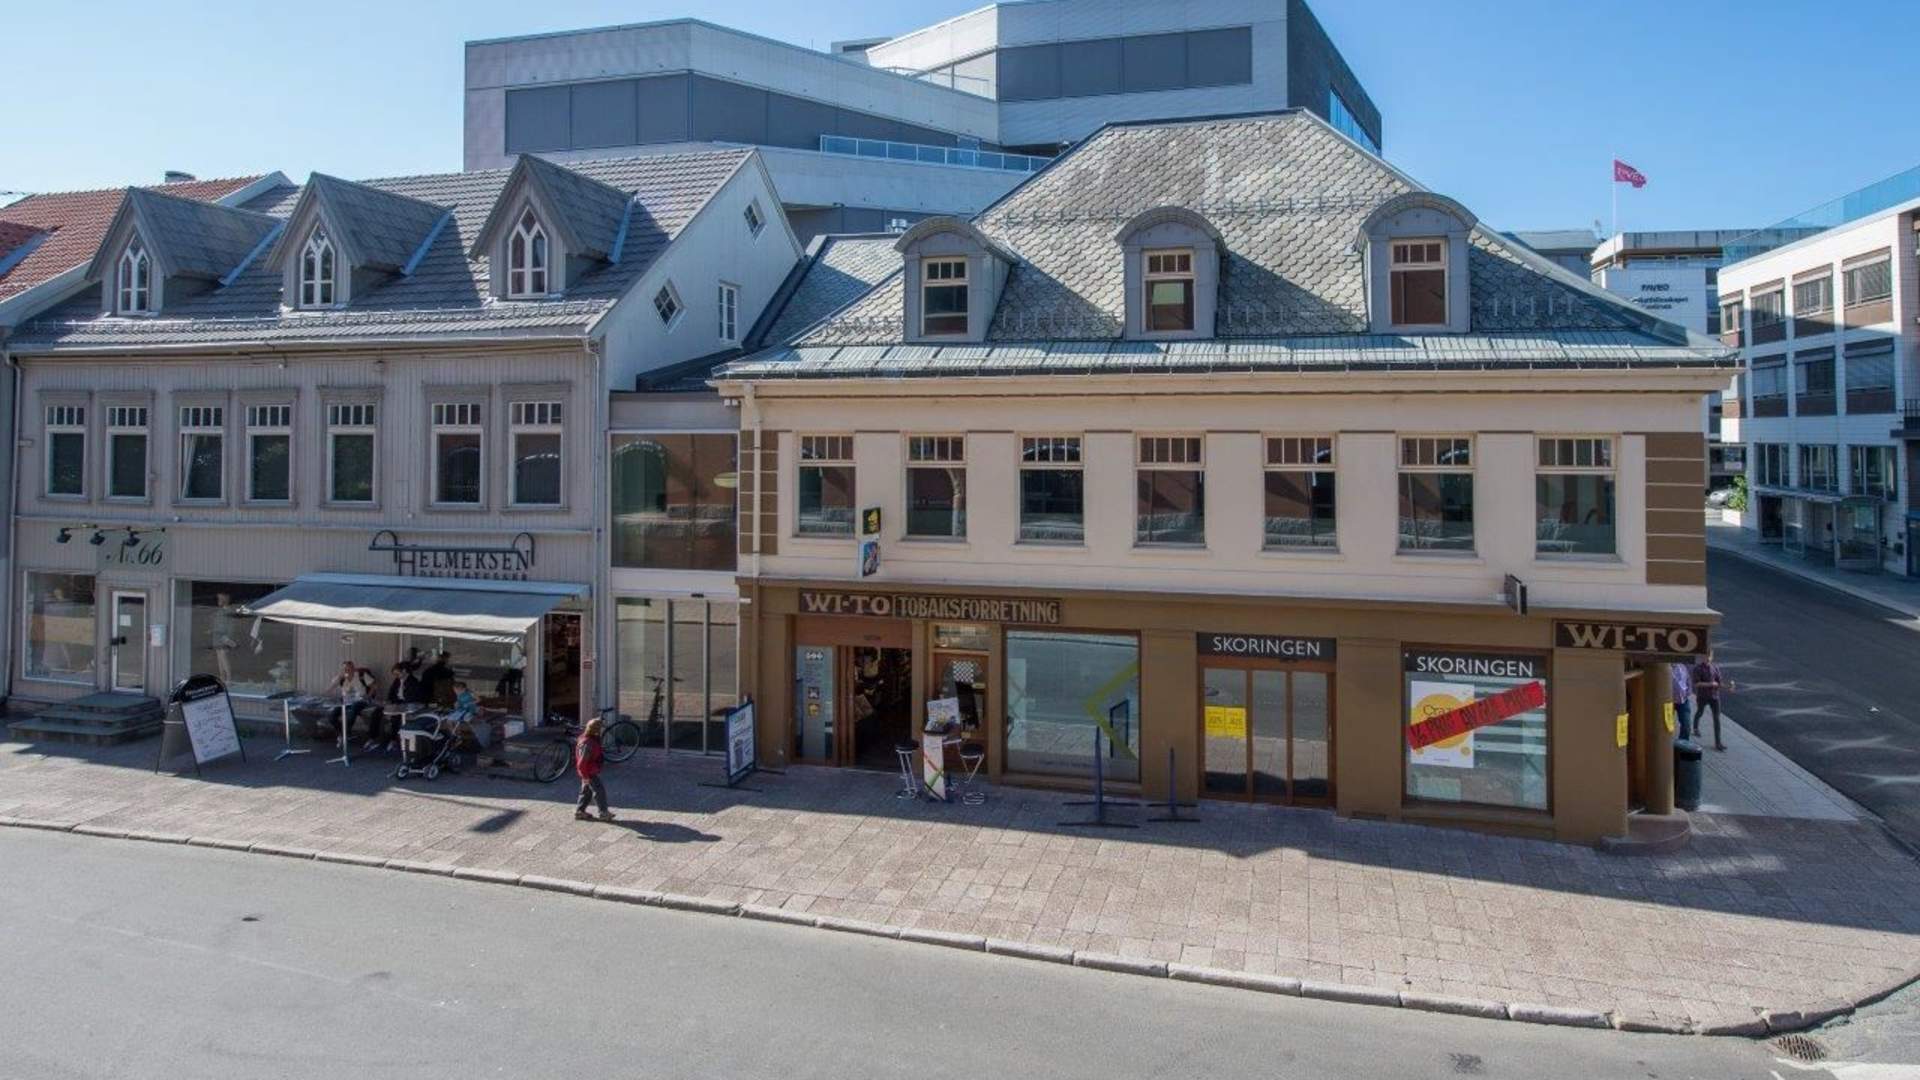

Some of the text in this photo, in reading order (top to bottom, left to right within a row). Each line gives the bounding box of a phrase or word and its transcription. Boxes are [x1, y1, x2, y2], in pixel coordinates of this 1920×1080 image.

[802, 592, 1058, 624] WI-TO TOBAKSFORRETNING
[1212, 636, 1320, 657] SKORINGEN
[1563, 623, 1699, 652] WI-TO
[1416, 656, 1533, 677] SKORINGEN
